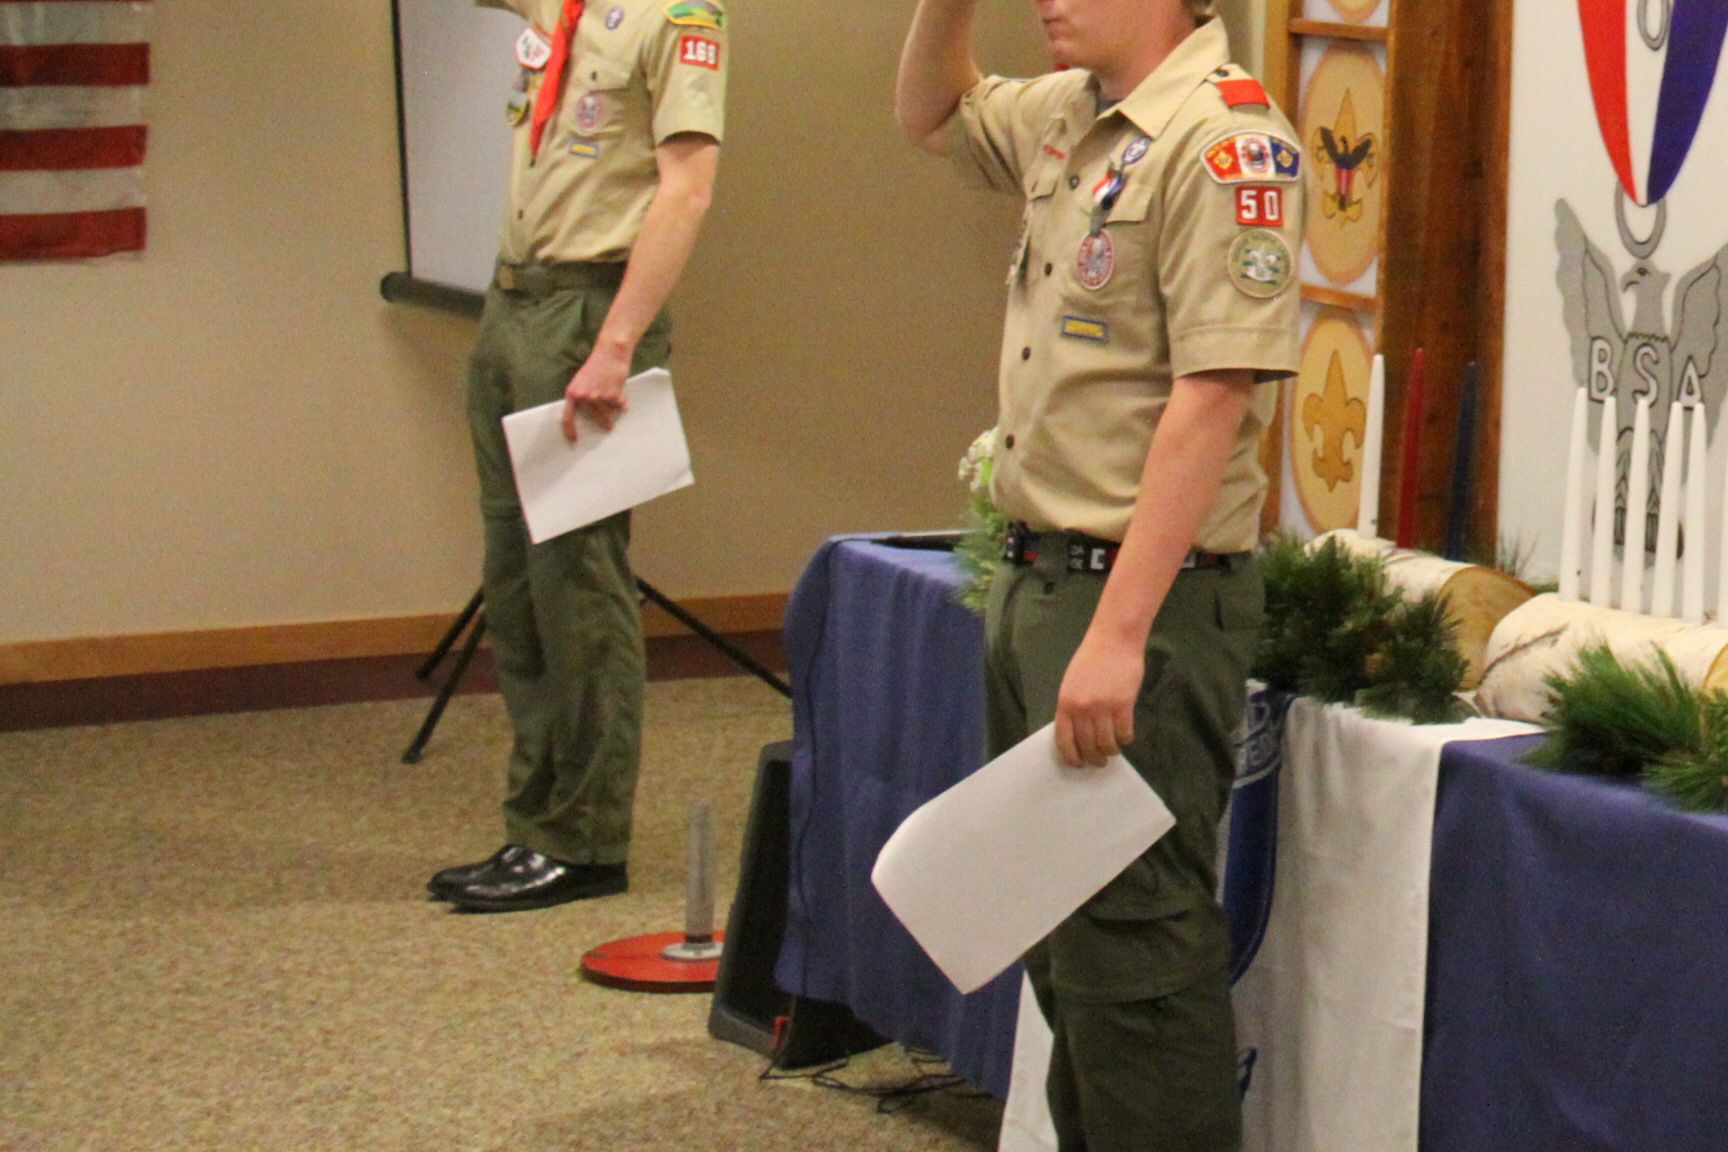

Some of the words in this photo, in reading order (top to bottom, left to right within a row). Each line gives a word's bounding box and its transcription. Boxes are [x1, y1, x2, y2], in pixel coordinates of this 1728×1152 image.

[683, 39, 717, 65] 168
[1240, 189, 1280, 222] 50
[1588, 336, 1705, 412] BSA
